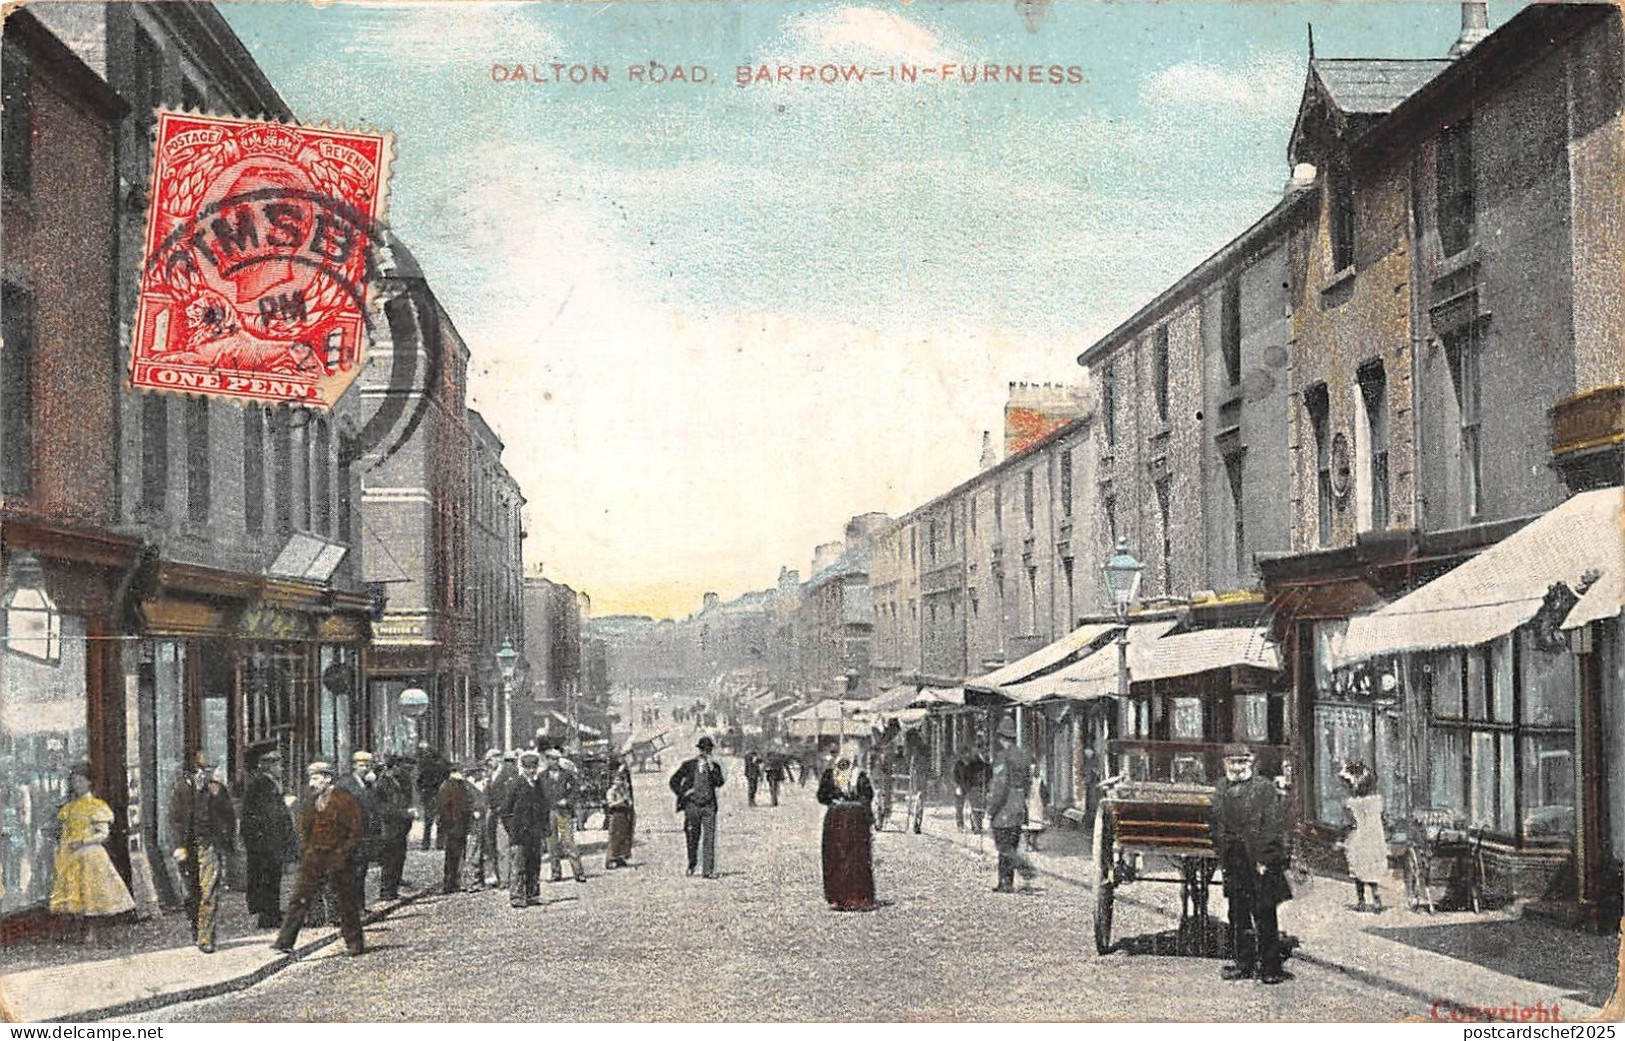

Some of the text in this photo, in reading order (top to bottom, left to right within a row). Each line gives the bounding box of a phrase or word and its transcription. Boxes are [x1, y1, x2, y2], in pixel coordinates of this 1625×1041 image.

[166, 131, 217, 155] POSTAGE
[325, 145, 372, 178] REVENUE
[150, 308, 170, 352] 1
[157, 369, 221, 388] ONE
